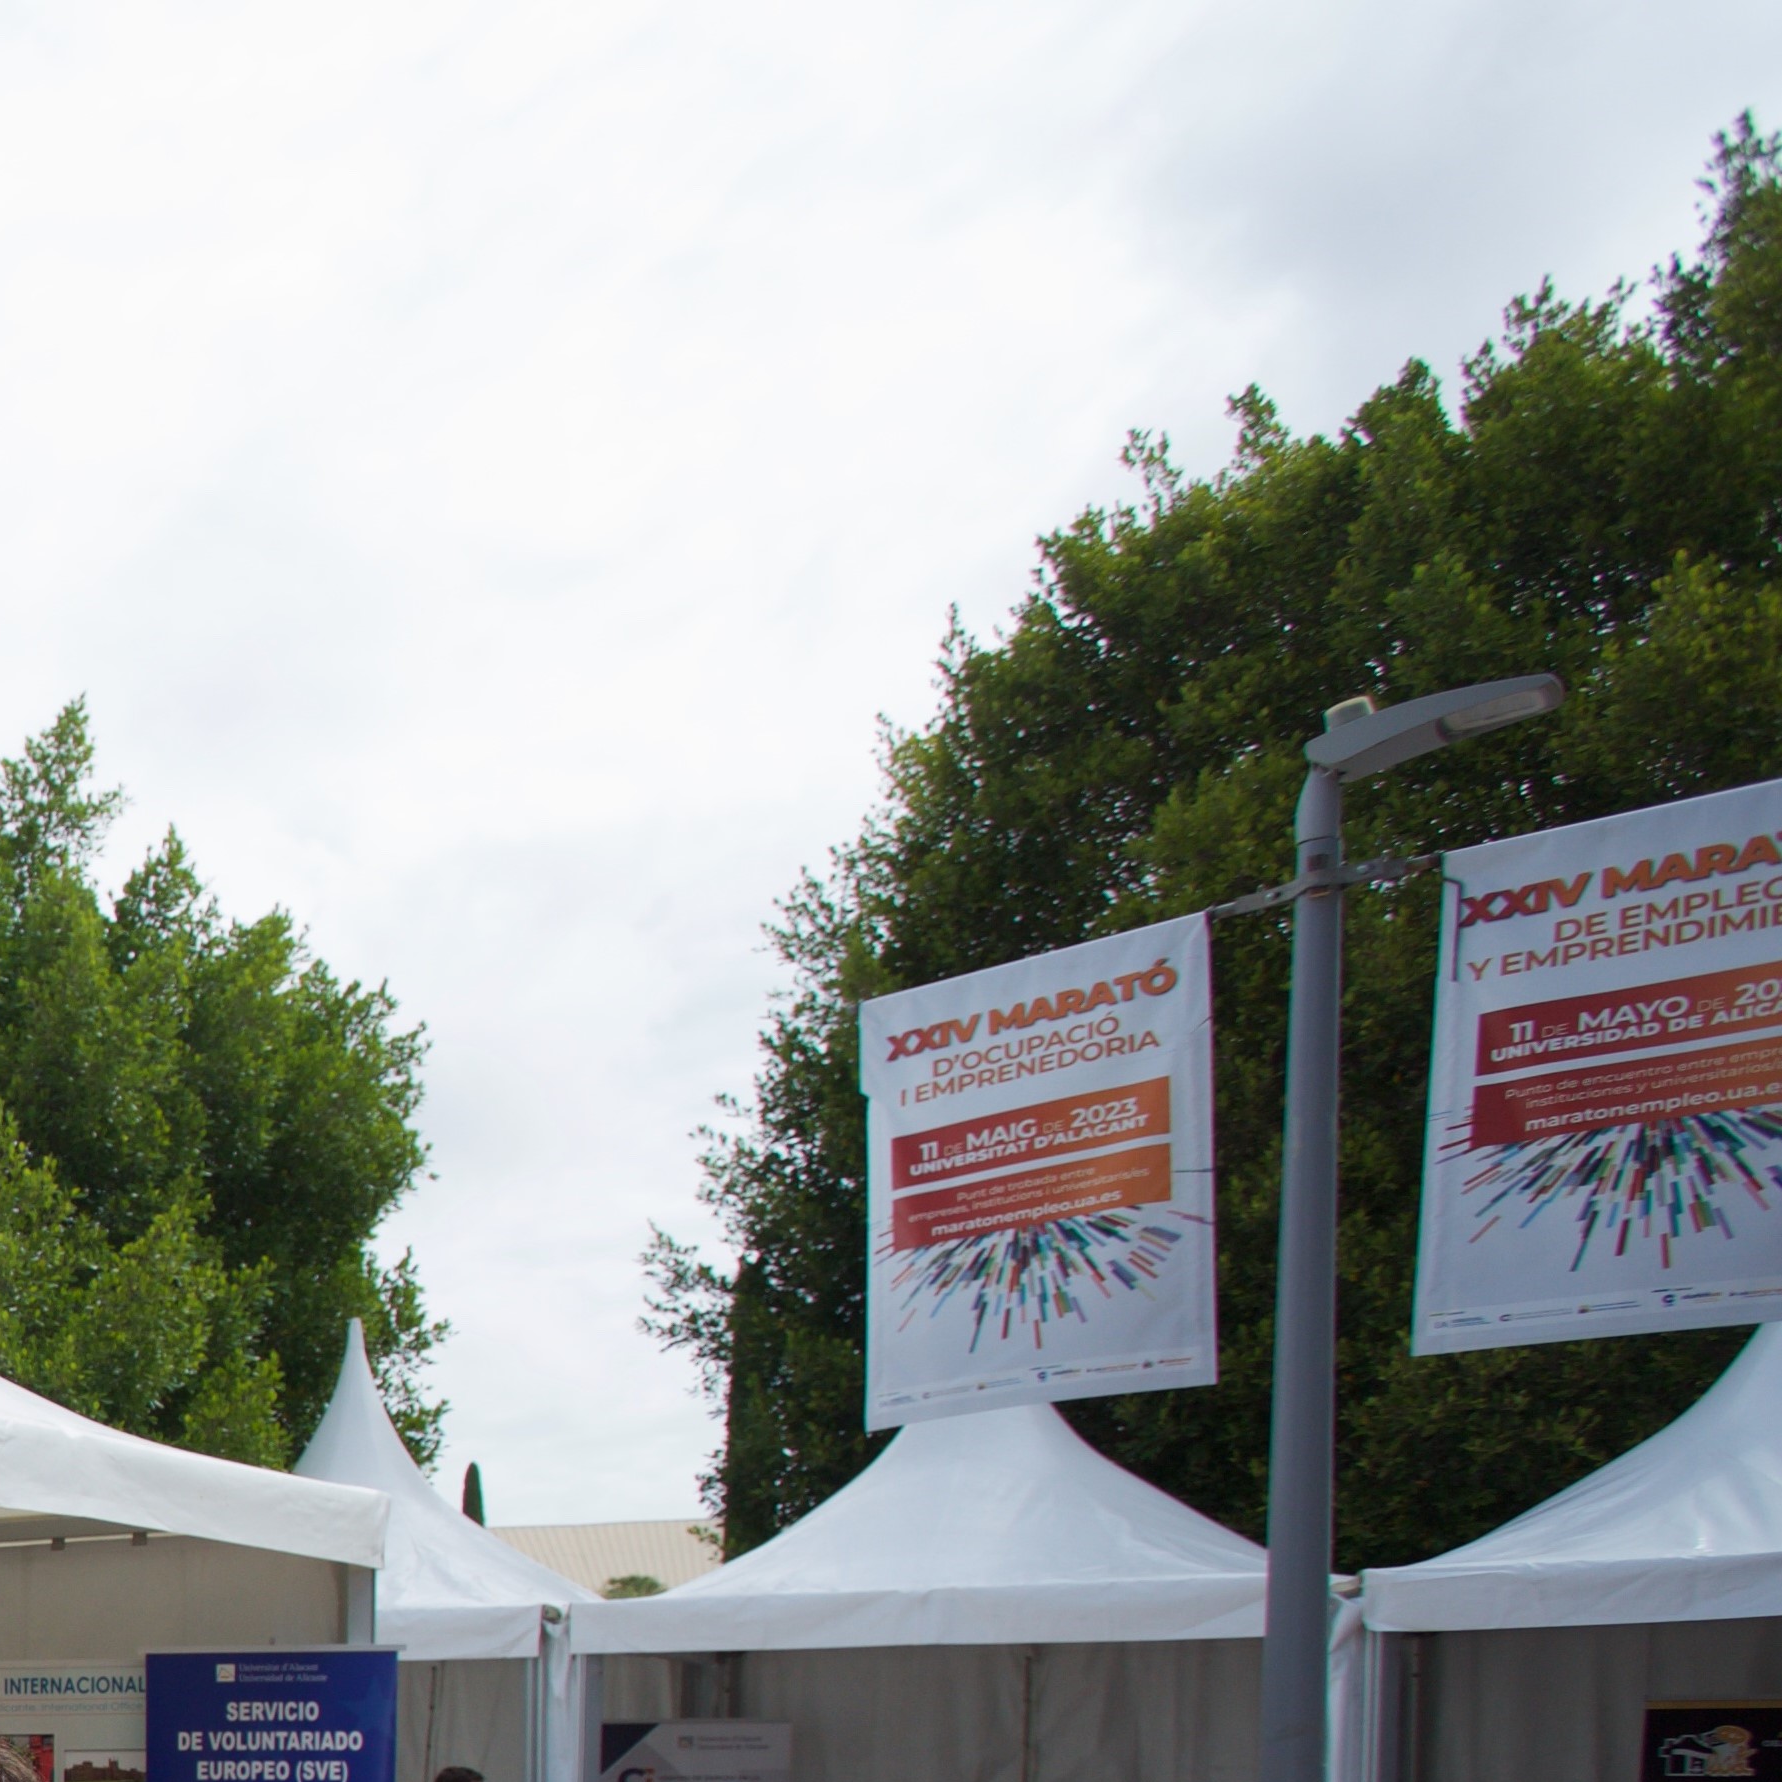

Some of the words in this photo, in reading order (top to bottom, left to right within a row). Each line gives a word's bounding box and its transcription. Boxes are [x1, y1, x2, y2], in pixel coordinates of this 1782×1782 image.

[1459, 872, 1592, 928] XXIV
[1554, 912, 1607, 942] DE
[1467, 957, 1493, 981] Y
[886, 1013, 982, 1062] XXIV
[989, 958, 1177, 1035] MARATÓ
[1509, 1020, 1534, 1042] 11
[1542, 1023, 1568, 1038] DE
[1578, 996, 1689, 1032] MAYO
[1697, 997, 1726, 1012] DE
[933, 1012, 1119, 1078] D'OCUPACIÓ
[1491, 1024, 1659, 1061] UNIVERSIDAD
[1668, 1015, 1702, 1032] DE
[901, 1089, 906, 1106] I
[915, 1030, 1159, 1103] EMPRENEDORIA
[1505, 1083, 1552, 1099] Punto
[1556, 1079, 1578, 1090] de
[1582, 1066, 1671, 1087] encuentro
[910, 1141, 1028, 1175] UNIVERSITAT
[1034, 1114, 1148, 1150] D'ALACANT
[919, 1141, 937, 1160] 11
[944, 1142, 962, 1156] DE
[966, 1119, 1037, 1150] MAIG
[1043, 1121, 1064, 1134] DE
[1070, 1097, 1137, 1128] 2023
[957, 1188, 986, 1202] Punt
[989, 1183, 1004, 1196] de
[1061, 1167, 1095, 1182] entre
[932, 1189, 1122, 1236] maratonempleo.ua.es
[4, 1676, 145, 1695] INTERNACIONAL
[226, 1701, 319, 1721] SERVICIO
[178, 1732, 203, 1750] DE
[208, 1731, 363, 1750] VOLUNTARIADO
[197, 1761, 290, 1780] EUROPEO
